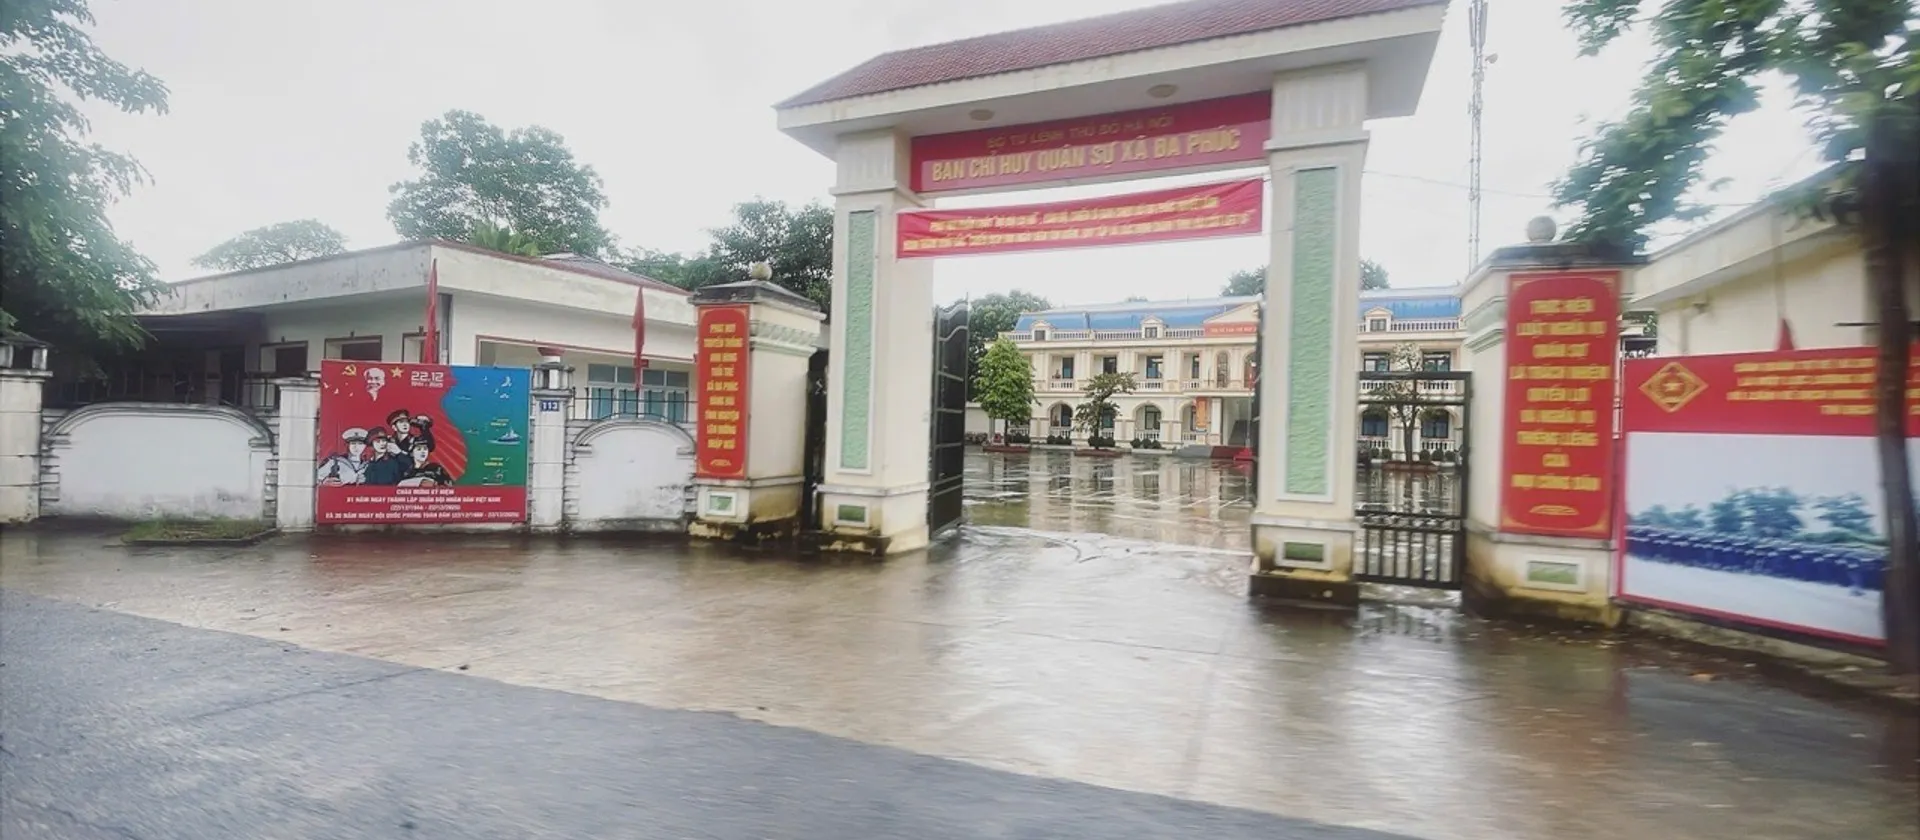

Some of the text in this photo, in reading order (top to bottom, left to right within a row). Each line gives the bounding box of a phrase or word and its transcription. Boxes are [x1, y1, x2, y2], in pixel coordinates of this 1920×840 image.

[932, 125, 1241, 182] BAN CHỈ HUY QUÂN SỰ XÃ ĐA PHÚC
[411, 371, 444, 382] 22.12
